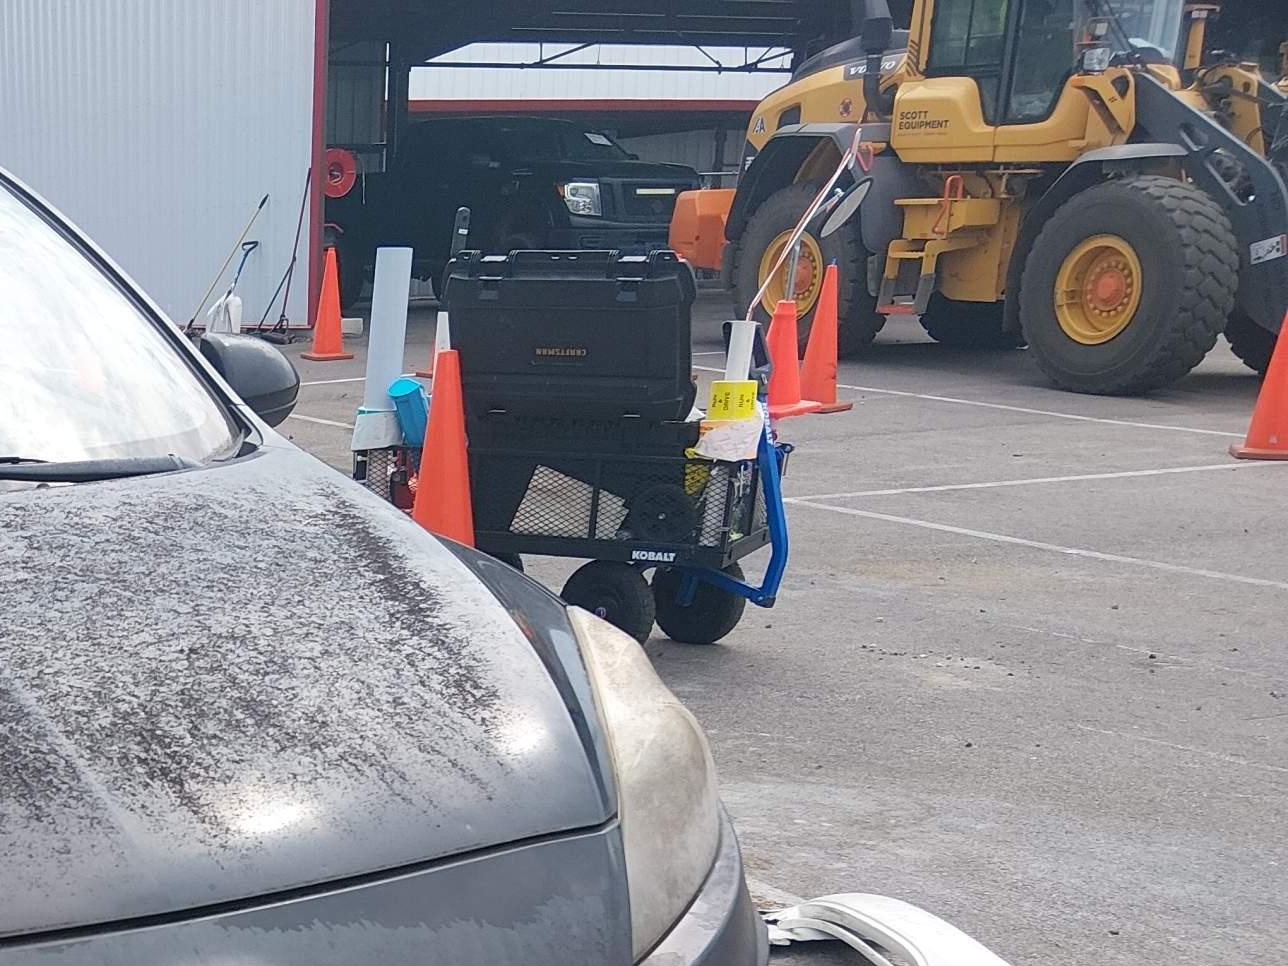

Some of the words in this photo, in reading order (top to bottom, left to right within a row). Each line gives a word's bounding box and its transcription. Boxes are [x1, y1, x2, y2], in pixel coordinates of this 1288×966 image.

[899, 110, 929, 120] SCOTT
[898, 119, 950, 130] EQUIPMENT
[632, 550, 676, 562] KOBALT
